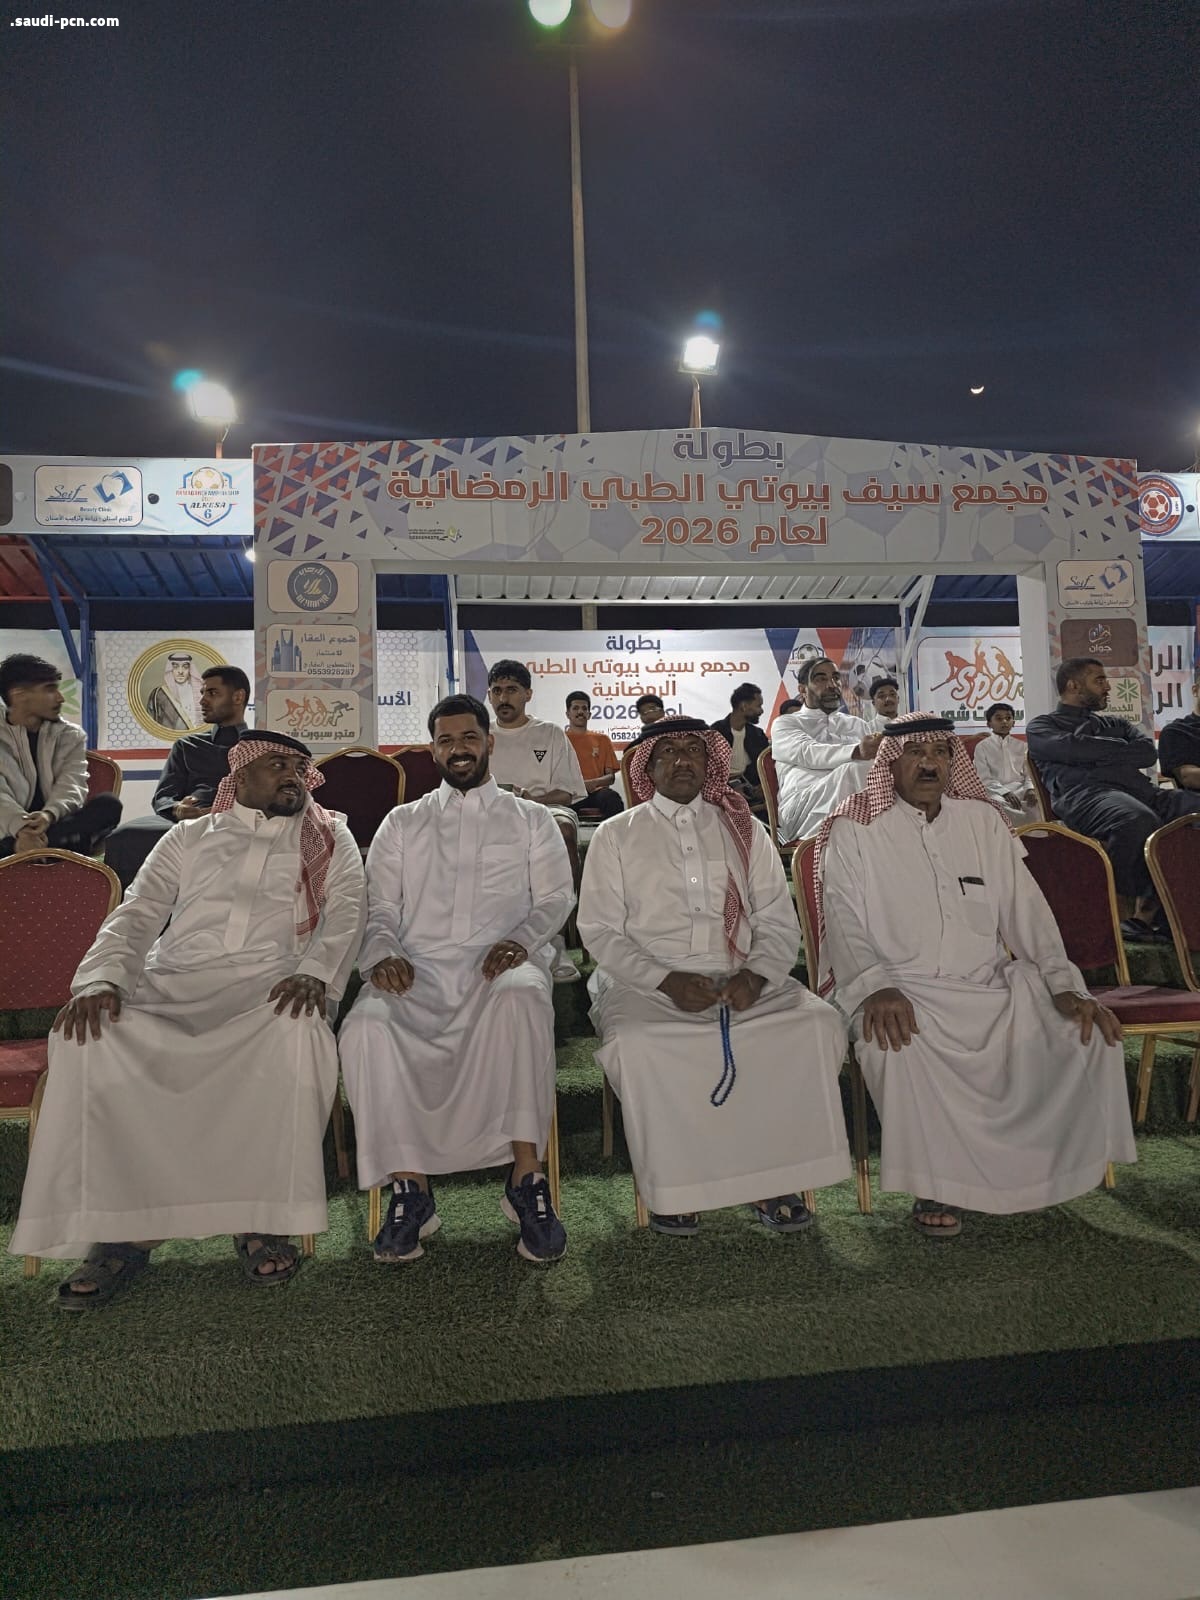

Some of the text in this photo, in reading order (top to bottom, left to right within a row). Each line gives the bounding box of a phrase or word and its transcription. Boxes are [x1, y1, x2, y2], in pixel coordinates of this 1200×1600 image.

[673, 431, 785, 469] بطولة
[387, 469, 1049, 512] مجمع سيف بيوتي الطبي الرمضانية
[204, 508, 212, 519] 6
[640, 515, 828, 554] لعام 2026
[606, 634, 661, 654] بطولة
[582, 659, 639, 678] بيوتي
[645, 658, 695, 677] سيف
[700, 661, 750, 677] مجمع
[592, 680, 677, 701] الرمضانية
[950, 665, 1024, 709] Spor
[287, 708, 341, 731] Sport
[591, 705, 639, 720] 2026
